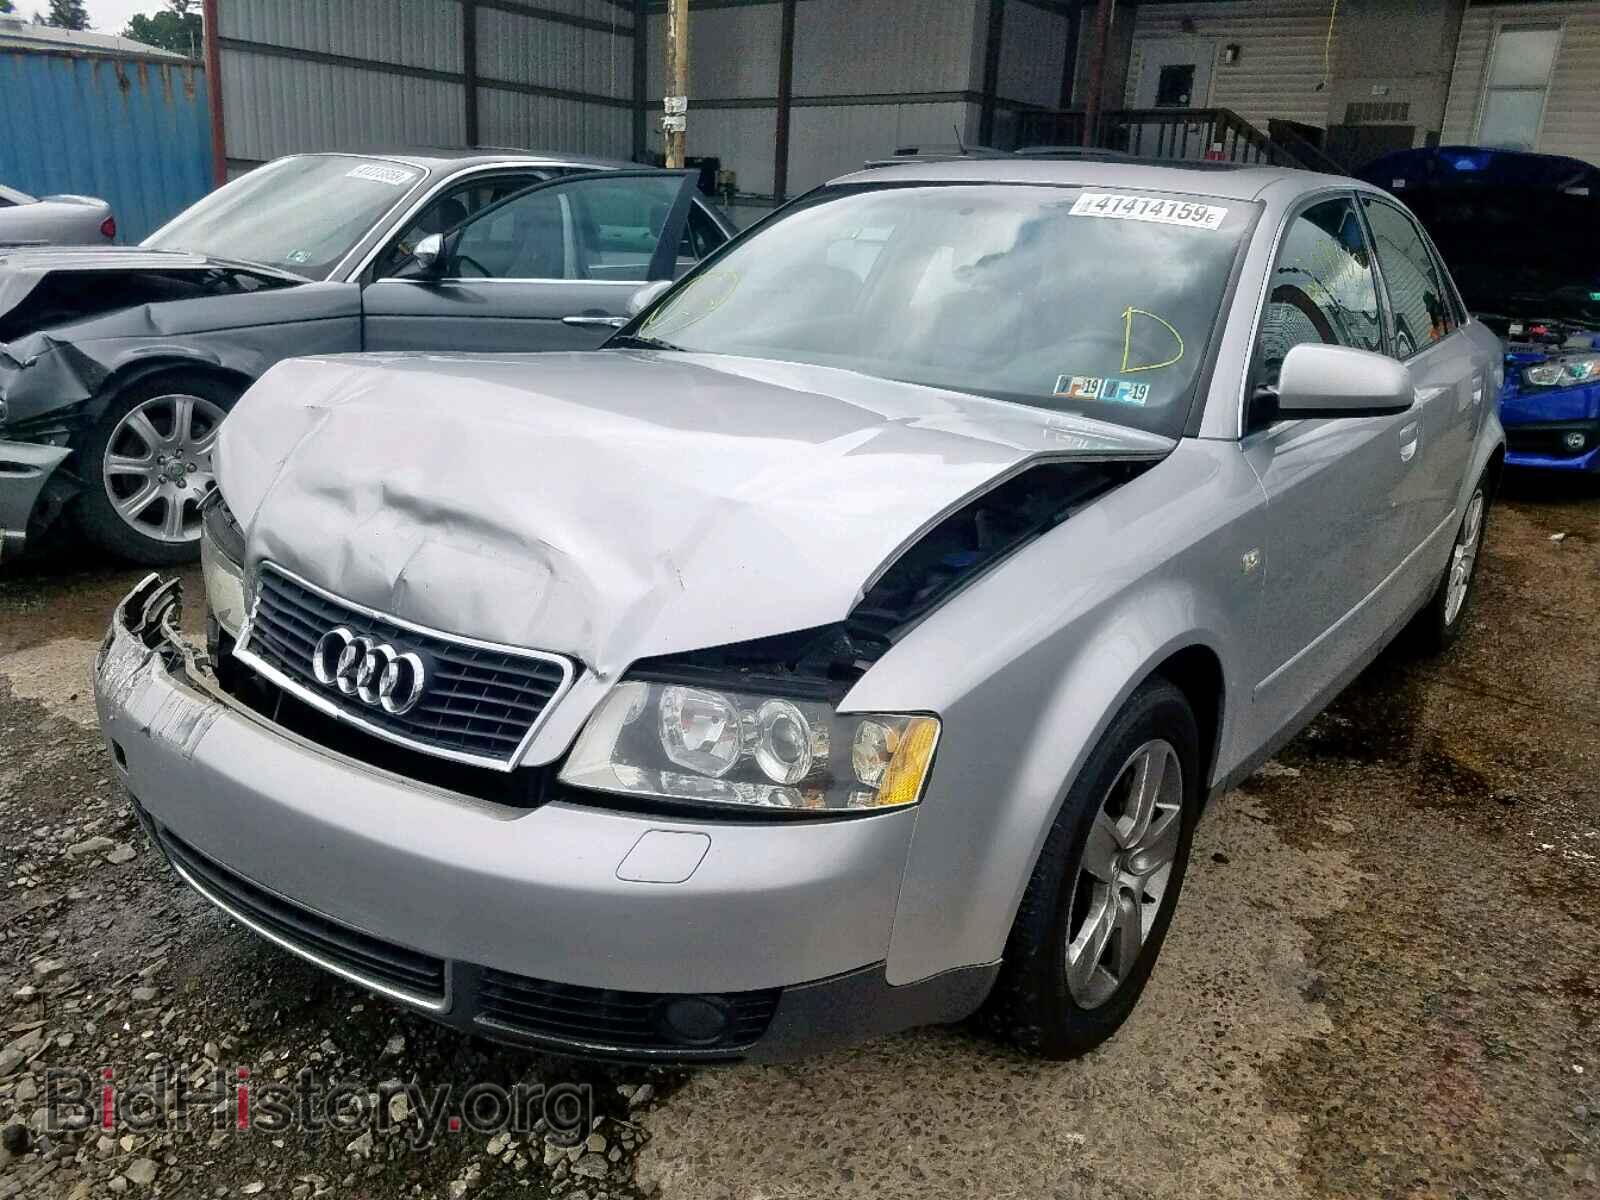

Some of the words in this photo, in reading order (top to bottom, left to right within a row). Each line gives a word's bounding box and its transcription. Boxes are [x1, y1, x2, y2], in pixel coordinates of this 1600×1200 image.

[1120, 306, 1184, 373] D
[1084, 378, 1098, 394] 19
[1132, 384, 1147, 400] 19
